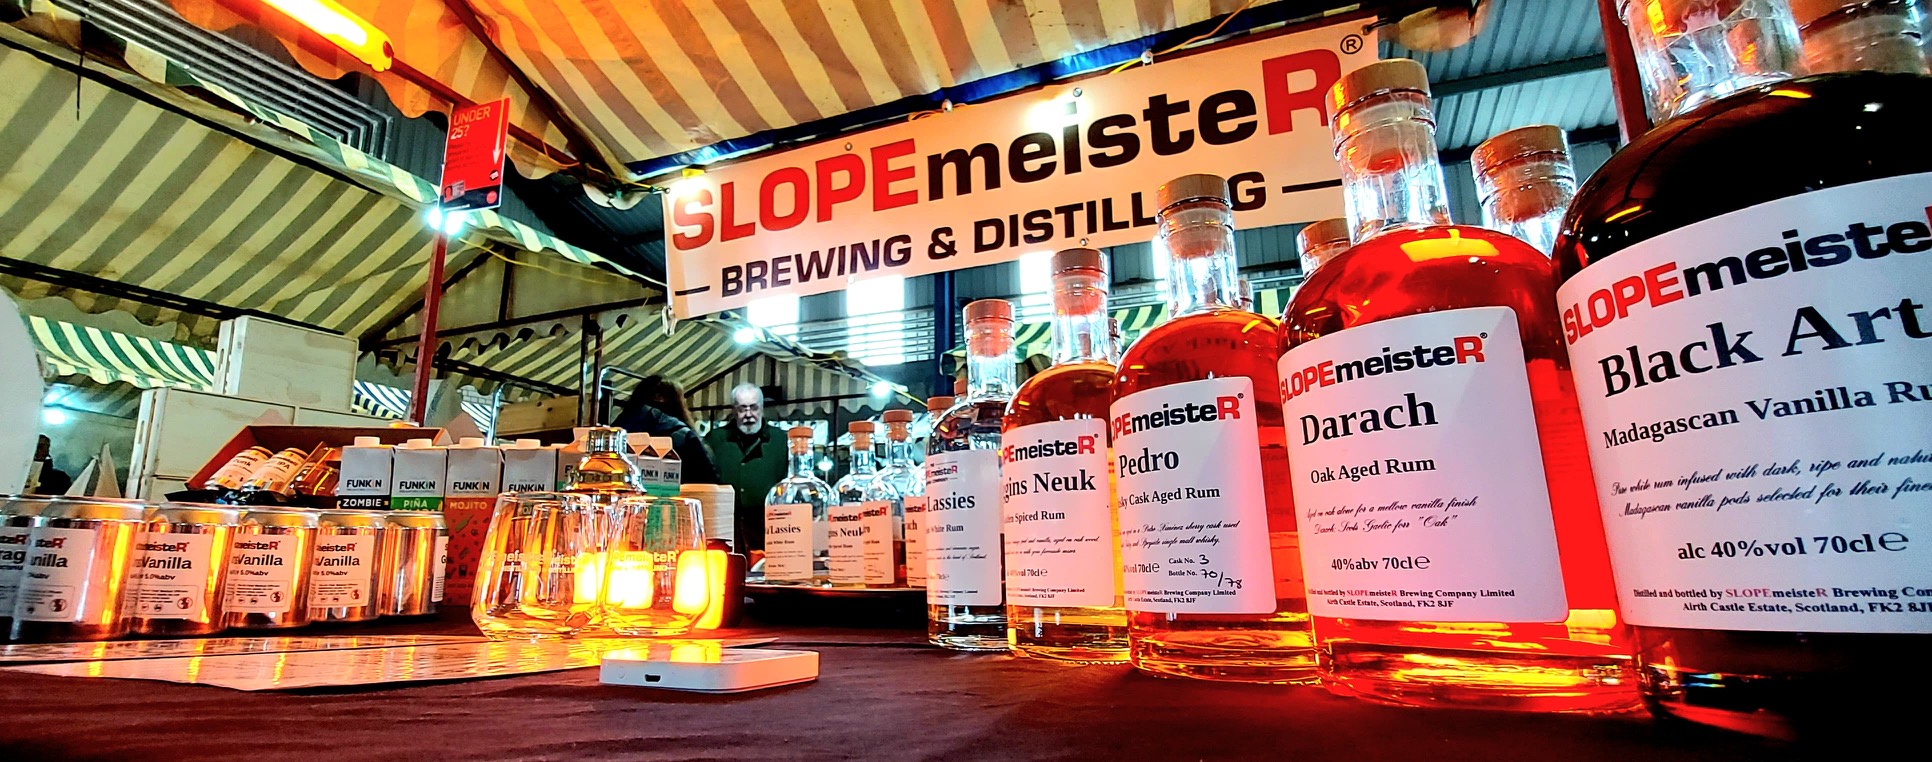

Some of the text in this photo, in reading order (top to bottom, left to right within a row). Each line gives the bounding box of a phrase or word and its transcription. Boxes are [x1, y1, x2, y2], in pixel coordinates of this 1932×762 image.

[453, 106, 490, 126] UNDER
[451, 124, 470, 140] 25?
[721, 170, 1267, 294] BREWING & DISTILLG
[1561, 206, 1932, 346] SLOPEmeiste
[1598, 298, 1932, 398] Black Art
[1299, 392, 1439, 446] Darach
[1602, 408, 1740, 449] Madagascan
[1745, 386, 1877, 421] Vanilla
[1118, 446, 1180, 479] Pedro
[1677, 469, 1723, 487] infused
[1726, 463, 1759, 480] with
[1762, 458, 1802, 477] dark,
[1809, 459, 1841, 477] ripe
[1846, 452, 1886, 469] and
[1310, 458, 1437, 484] Oak Aged Rum
[346, 479, 382, 489] FUNKIN
[399, 480, 436, 490] FUNKIN
[453, 481, 490, 491] FUNKIN
[1033, 468, 1097, 494] Neuk
[342, 498, 382, 507] ZOMBIE
[403, 497, 428, 508] PIÑA
[927, 491, 976, 512] Lassies
[1129, 486, 1221, 506] Cask Aged Rum
[1619, 501, 1671, 519] Madagascan
[1675, 495, 1716, 510] vanilla
[1716, 490, 1751, 512] pods
[1756, 487, 1813, 504] selected
[1814, 483, 1843, 504] for
[1849, 480, 1889, 496] their
[449, 500, 488, 510] MOJITO
[1377, 500, 1408, 512] mellow
[1411, 498, 1444, 510] vanilla
[1444, 495, 1479, 512] finish
[1014, 511, 1039, 524] Spiced
[1041, 510, 1066, 520] Rum
[770, 524, 802, 535] Lassies
[946, 523, 964, 532] Rum
[1362, 518, 1392, 533] Gaelic
[1678, 542, 1707, 560] alc
[1710, 537, 1808, 558] 40%vol
[1199, 554, 1210, 565] 3
[1331, 557, 1379, 571] 40%abv
[1186, 569, 1198, 577] No.
[1184, 589, 1211, 598] Company
[1212, 589, 1237, 597] Limited
[1399, 589, 1434, 599] Brewing
[1435, 589, 1478, 600] Company
[1480, 588, 1516, 598] Limited
[1658, 588, 1674, 598] and
[1674, 588, 1708, 598] bottled
[1709, 589, 1723, 600] by
[1725, 587, 1829, 599] SLOPEmeisteR
[1832, 587, 1899, 600] Brewing
[1380, 599, 1416, 608] Scotland,
[1417, 600, 1436, 608] FK2
[1682, 602, 1708, 611] Airth
[1709, 602, 1745, 612] Castle
[1749, 602, 1793, 614] Estate,
[1795, 602, 1865, 614] Scotland,
[1868, 602, 1904, 612] FK2
